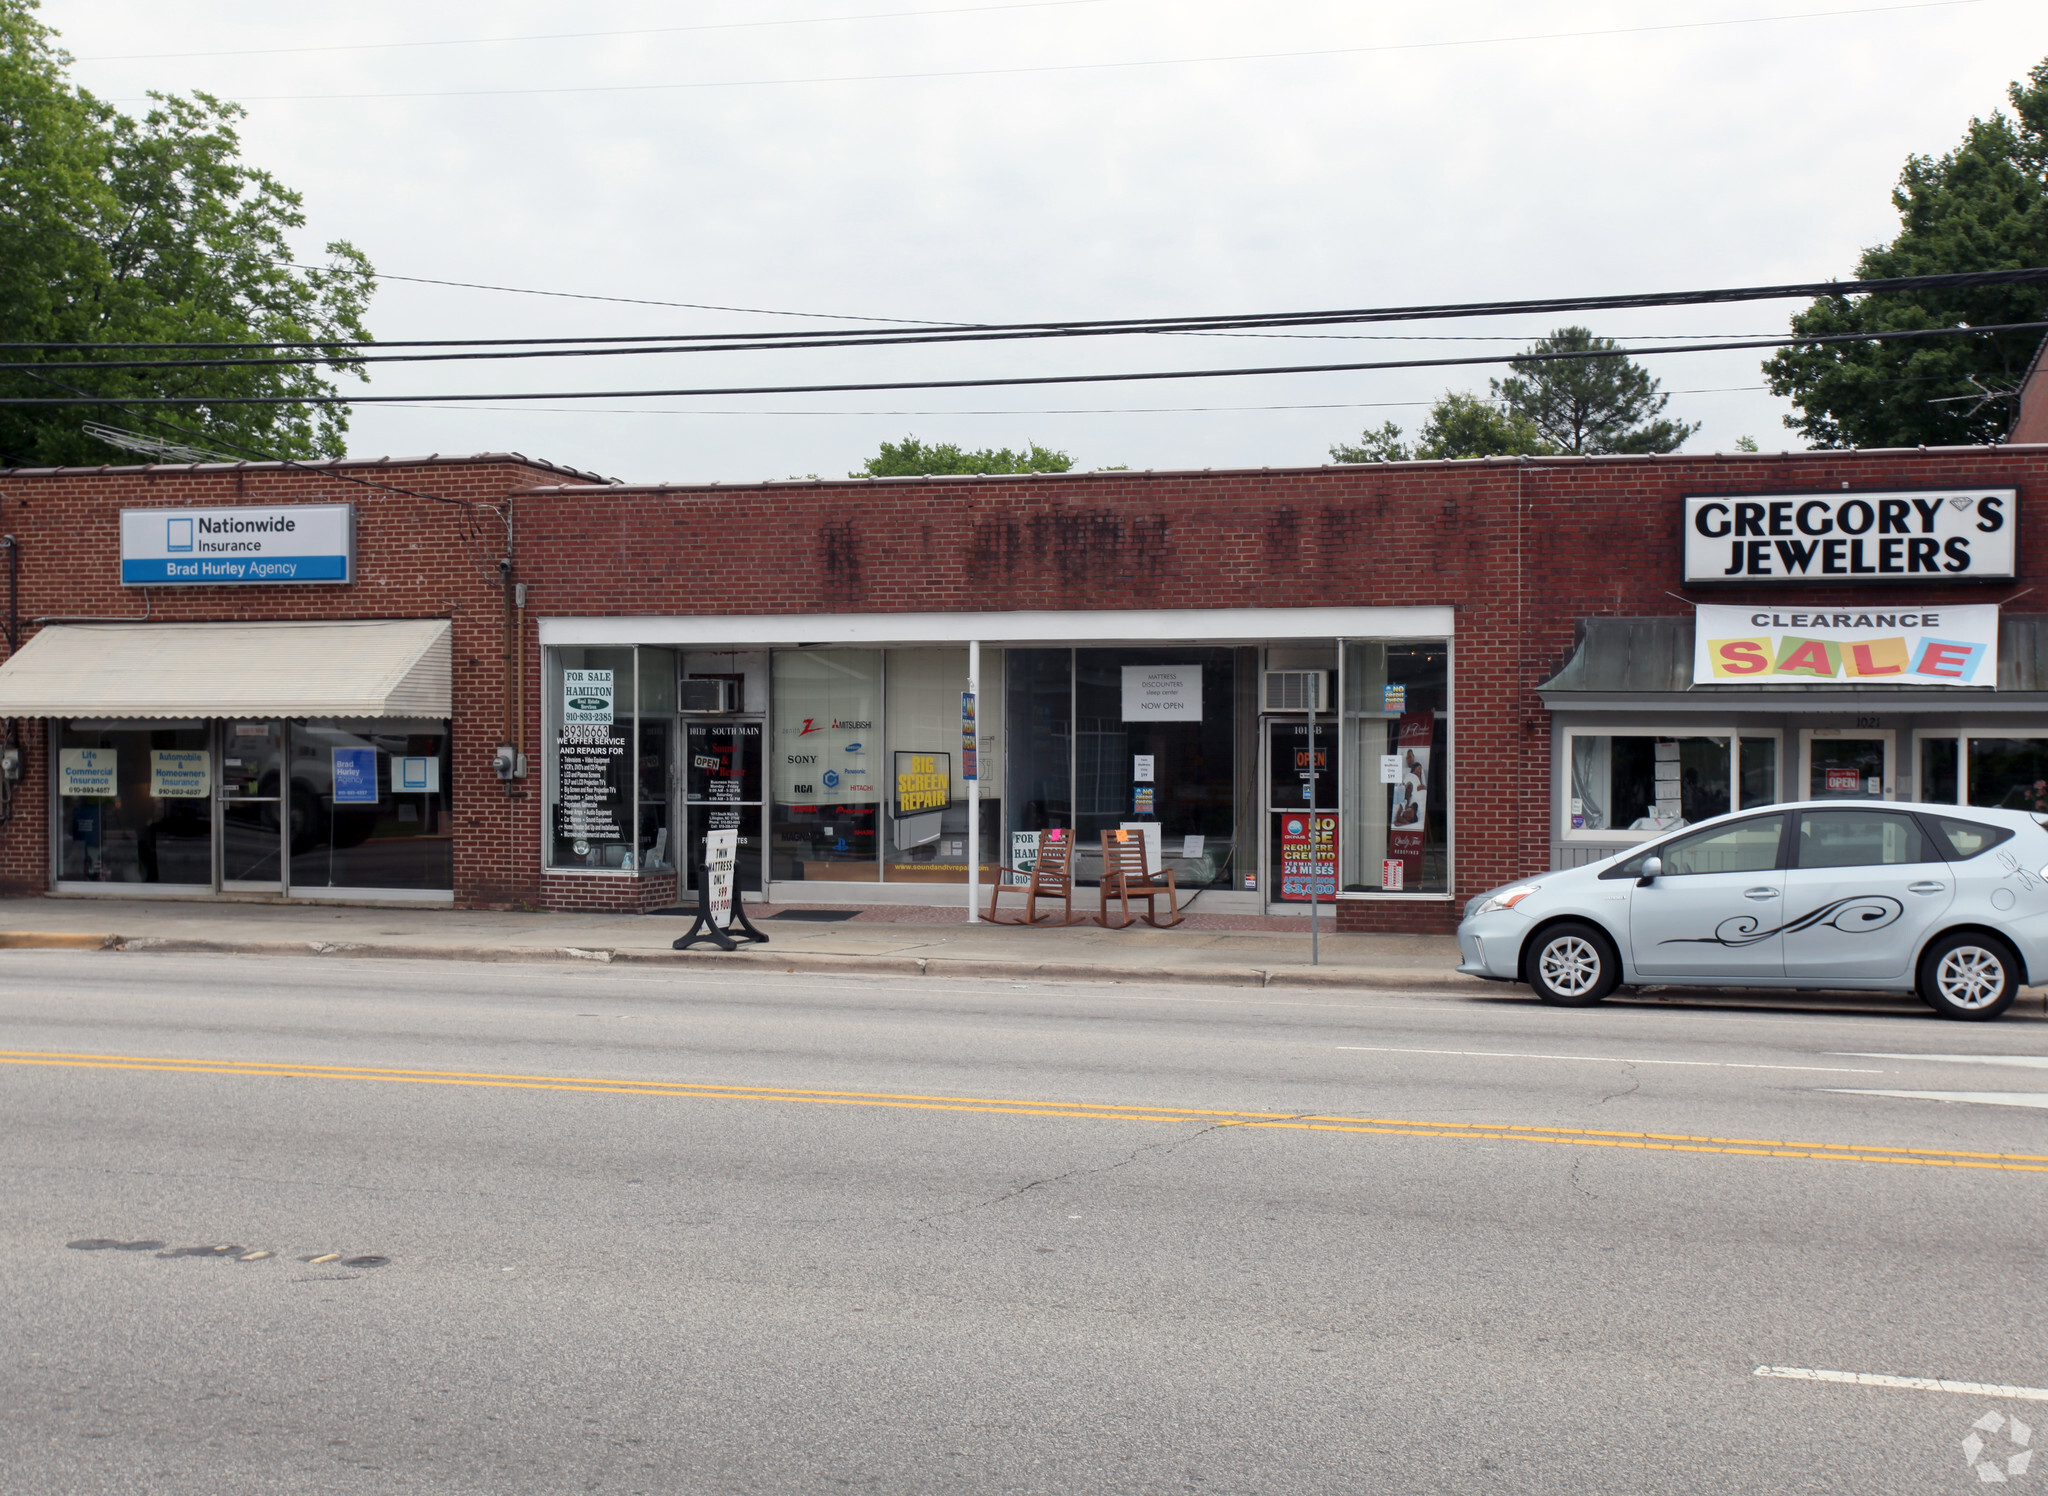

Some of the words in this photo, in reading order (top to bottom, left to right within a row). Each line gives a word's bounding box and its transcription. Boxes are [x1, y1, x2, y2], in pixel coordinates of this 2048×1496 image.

[198, 516, 296, 533] Nationwide
[198, 540, 262, 552] Insurance
[1724, 537, 1971, 575] JEWELERS
[166, 562, 198, 576] Brad
[202, 562, 246, 578] Hurley
[249, 561, 297, 577] Agency
[1751, 613, 1940, 628] CLEARANCE
[1719, 640, 1974, 678] SALE
[567, 672, 584, 681] FOR
[588, 672, 611, 681] SALE
[566, 686, 612, 696] HAMILTON
[839, 721, 871, 729] MITSUBISHI
[1856, 717, 1880, 728] 1021
[564, 726, 582, 737] 893
[584, 726, 608, 737] 6663
[712, 744, 738, 752] Sound
[82, 751, 97, 760] Life
[159, 752, 202, 761] Automobile
[721, 756, 728, 765] &
[788, 755, 817, 764] SONY
[1297, 752, 1325, 766] OPEN
[696, 757, 719, 768] OPEN
[912, 756, 934, 773] BIG
[66, 768, 113, 776] Commercial
[156, 769, 206, 777] Homeowners
[337, 768, 360, 777] Hurley
[720, 767, 746, 779] Repair
[70, 776, 109, 784] Insurance
[162, 778, 199, 786] Insurance
[338, 776, 363, 784] Agency
[898, 774, 948, 792] SCREEN
[1829, 778, 1856, 787] OPEN
[794, 785, 812, 793] RCA
[901, 790, 946, 812] REPAIR
[1308, 818, 1336, 830] NO
[1016, 834, 1034, 843] FOR
[1308, 831, 1333, 844] SE
[709, 861, 732, 872] MATTRESS
[1284, 866, 1297, 874] 24
[714, 874, 725, 885] ONLY
[1284, 884, 1335, 896] $3,000
[711, 901, 719, 912] 893
